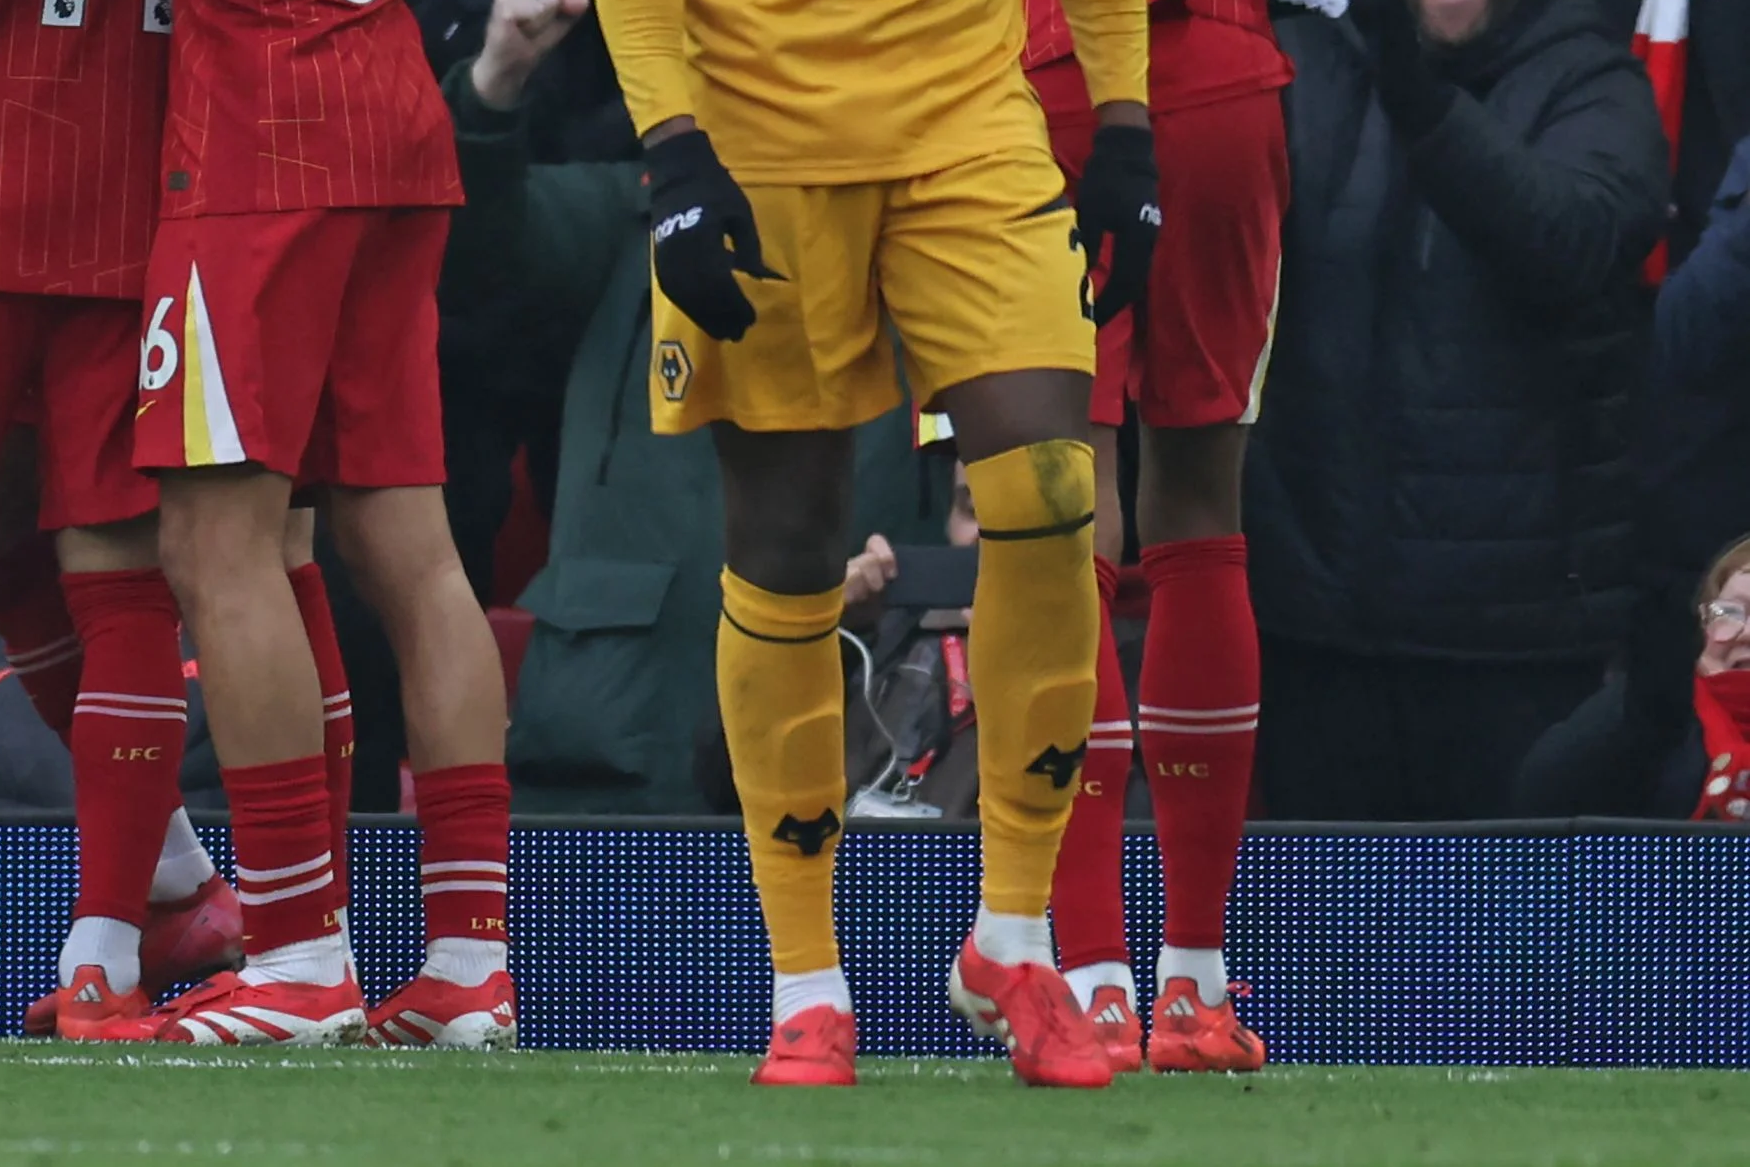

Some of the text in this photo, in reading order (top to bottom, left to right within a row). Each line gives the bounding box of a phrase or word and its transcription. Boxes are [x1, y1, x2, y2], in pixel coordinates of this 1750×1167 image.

[139, 296, 178, 391] 6
[112, 746, 162, 761] LFC
[1157, 762, 1209, 777] LFC
[471, 917, 506, 931] LFC
